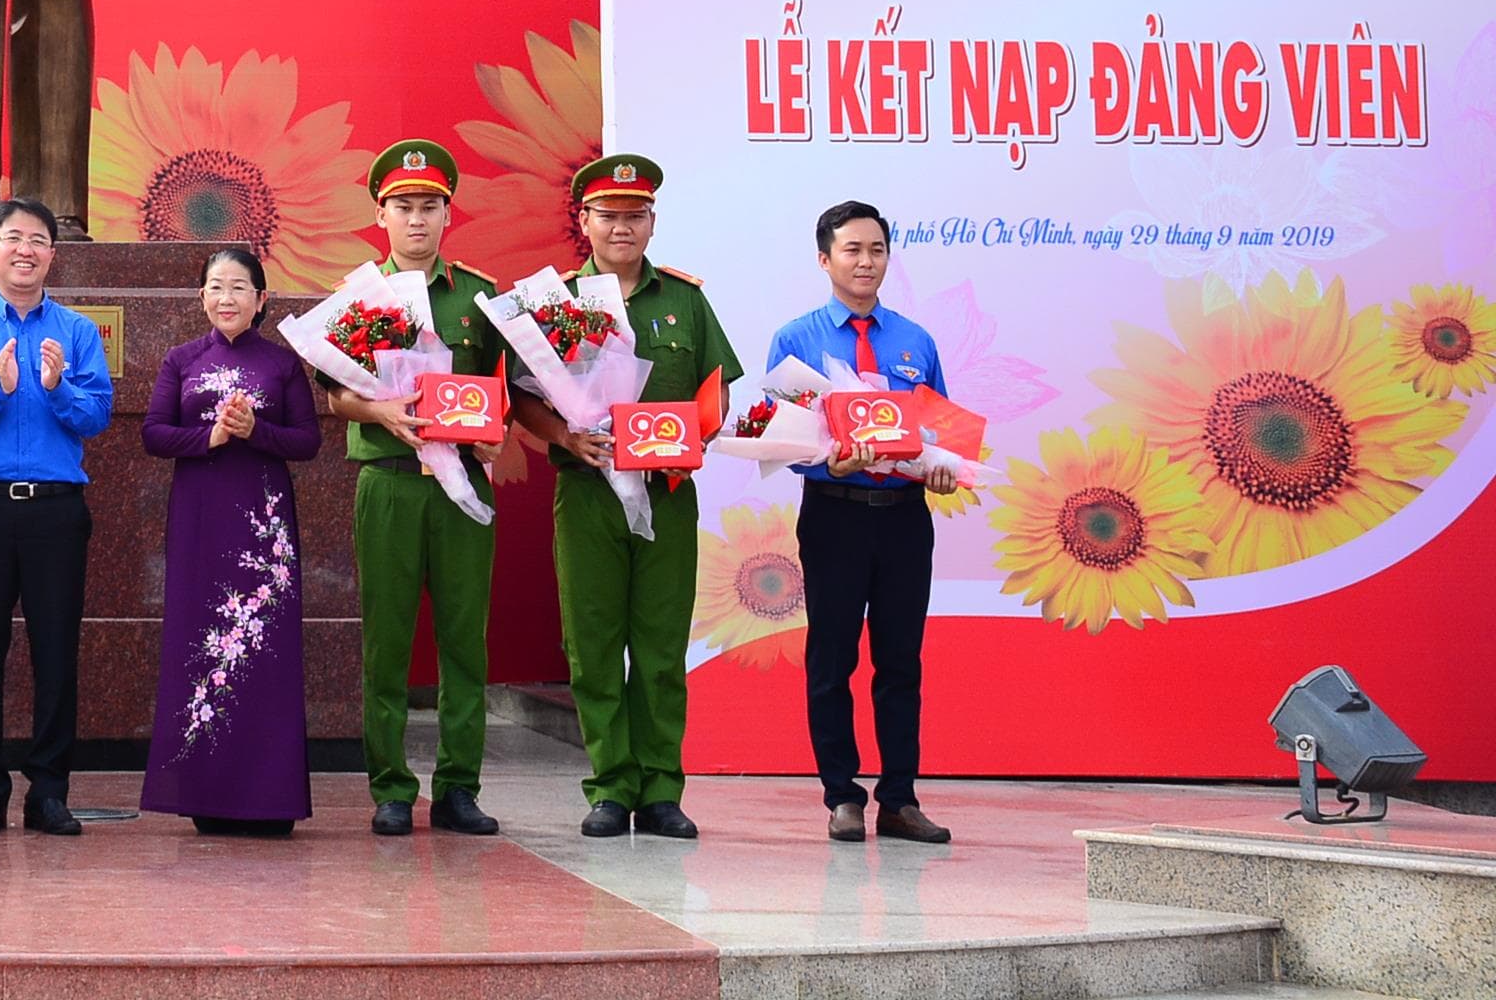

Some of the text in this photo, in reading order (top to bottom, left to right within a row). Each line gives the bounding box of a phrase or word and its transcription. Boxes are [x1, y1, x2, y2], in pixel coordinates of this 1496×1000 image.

[745, 0, 1425, 163] LỄ KẾT NẠP ĐẢNG VIÊN
[902, 220, 936, 249] phố
[940, 217, 977, 247] Hồ
[982, 217, 1015, 247] Chí
[1019, 217, 1077, 247] Minh,
[1082, 226, 1124, 251] ngày
[1130, 225, 1160, 246] 29
[1165, 223, 1214, 251] tháng
[1217, 225, 1233, 246] 9
[1238, 227, 1274, 246] năm
[1281, 226, 1335, 247] 2019
